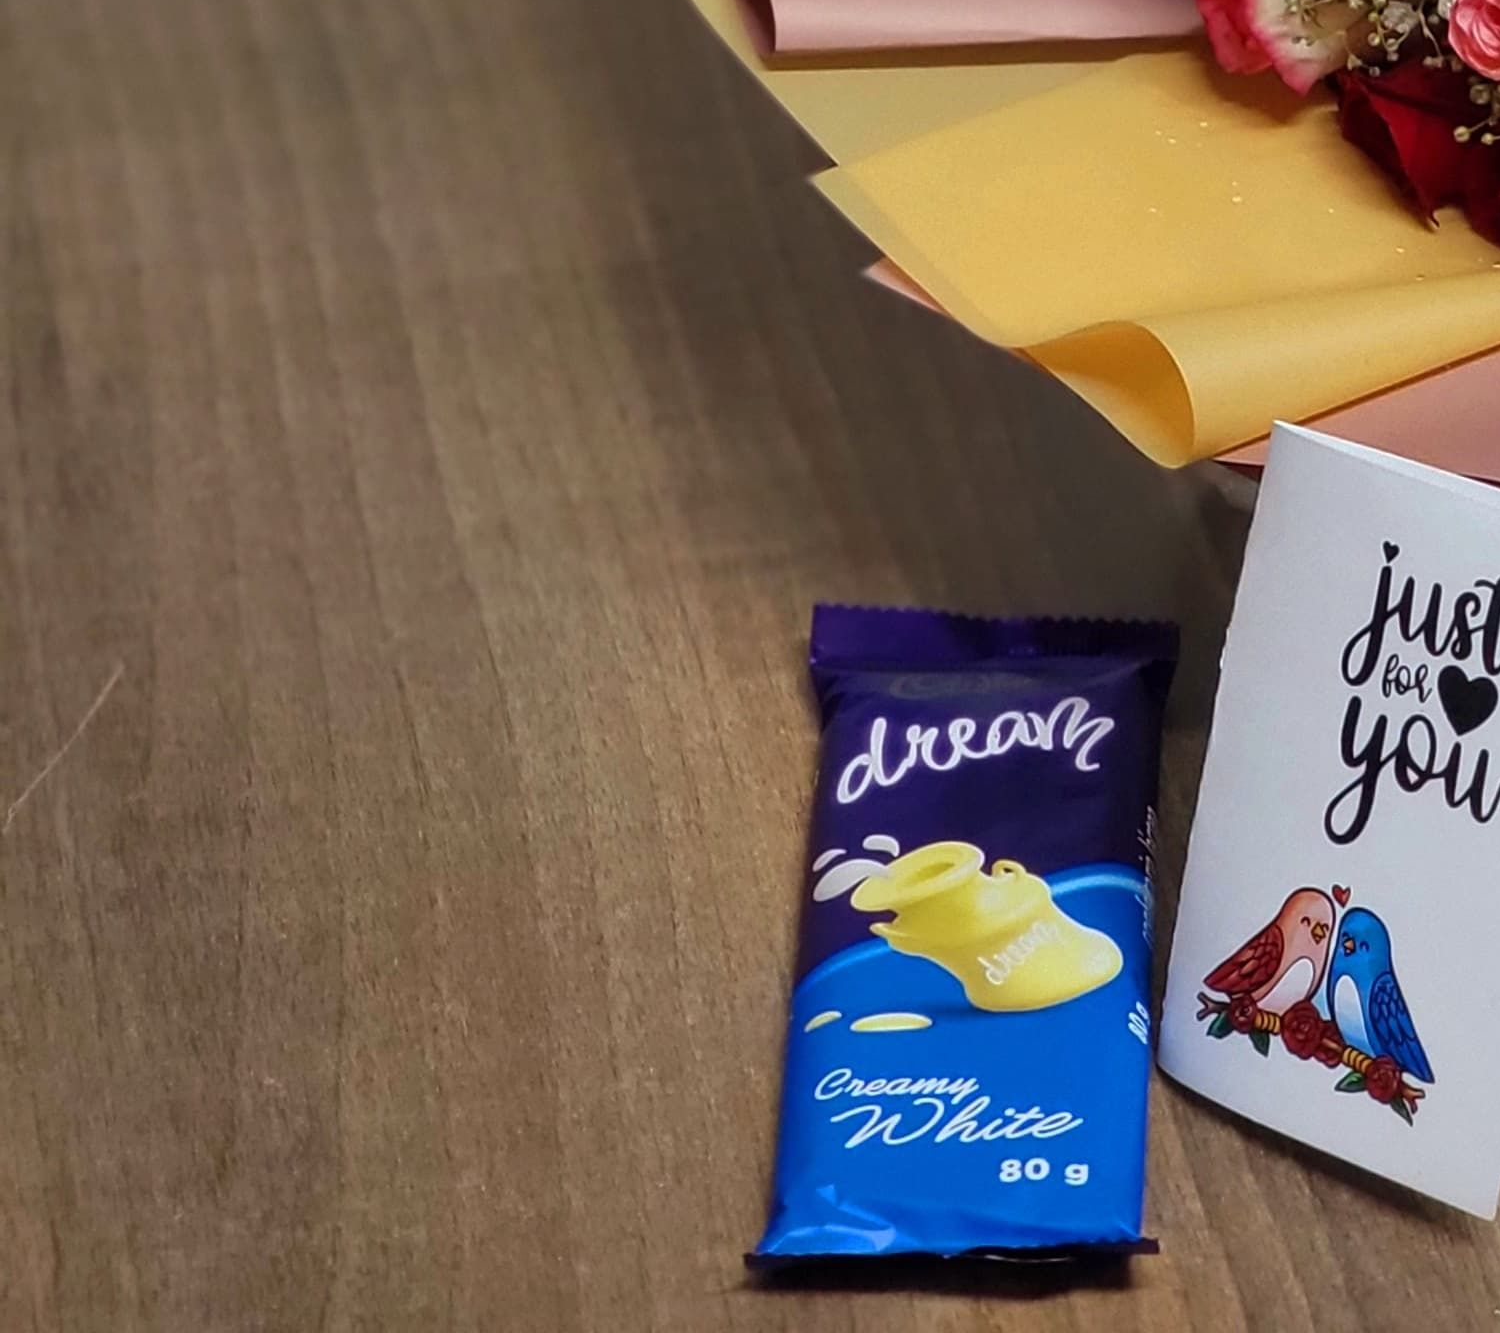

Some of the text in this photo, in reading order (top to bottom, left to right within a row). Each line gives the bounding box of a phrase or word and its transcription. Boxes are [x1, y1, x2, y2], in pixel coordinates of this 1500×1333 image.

[1381, 654, 1432, 704] for
[836, 696, 1116, 804] dream
[814, 1068, 980, 1105] Creamy
[830, 1095, 1084, 1149] White
[999, 1158, 1090, 1186] 80 g
